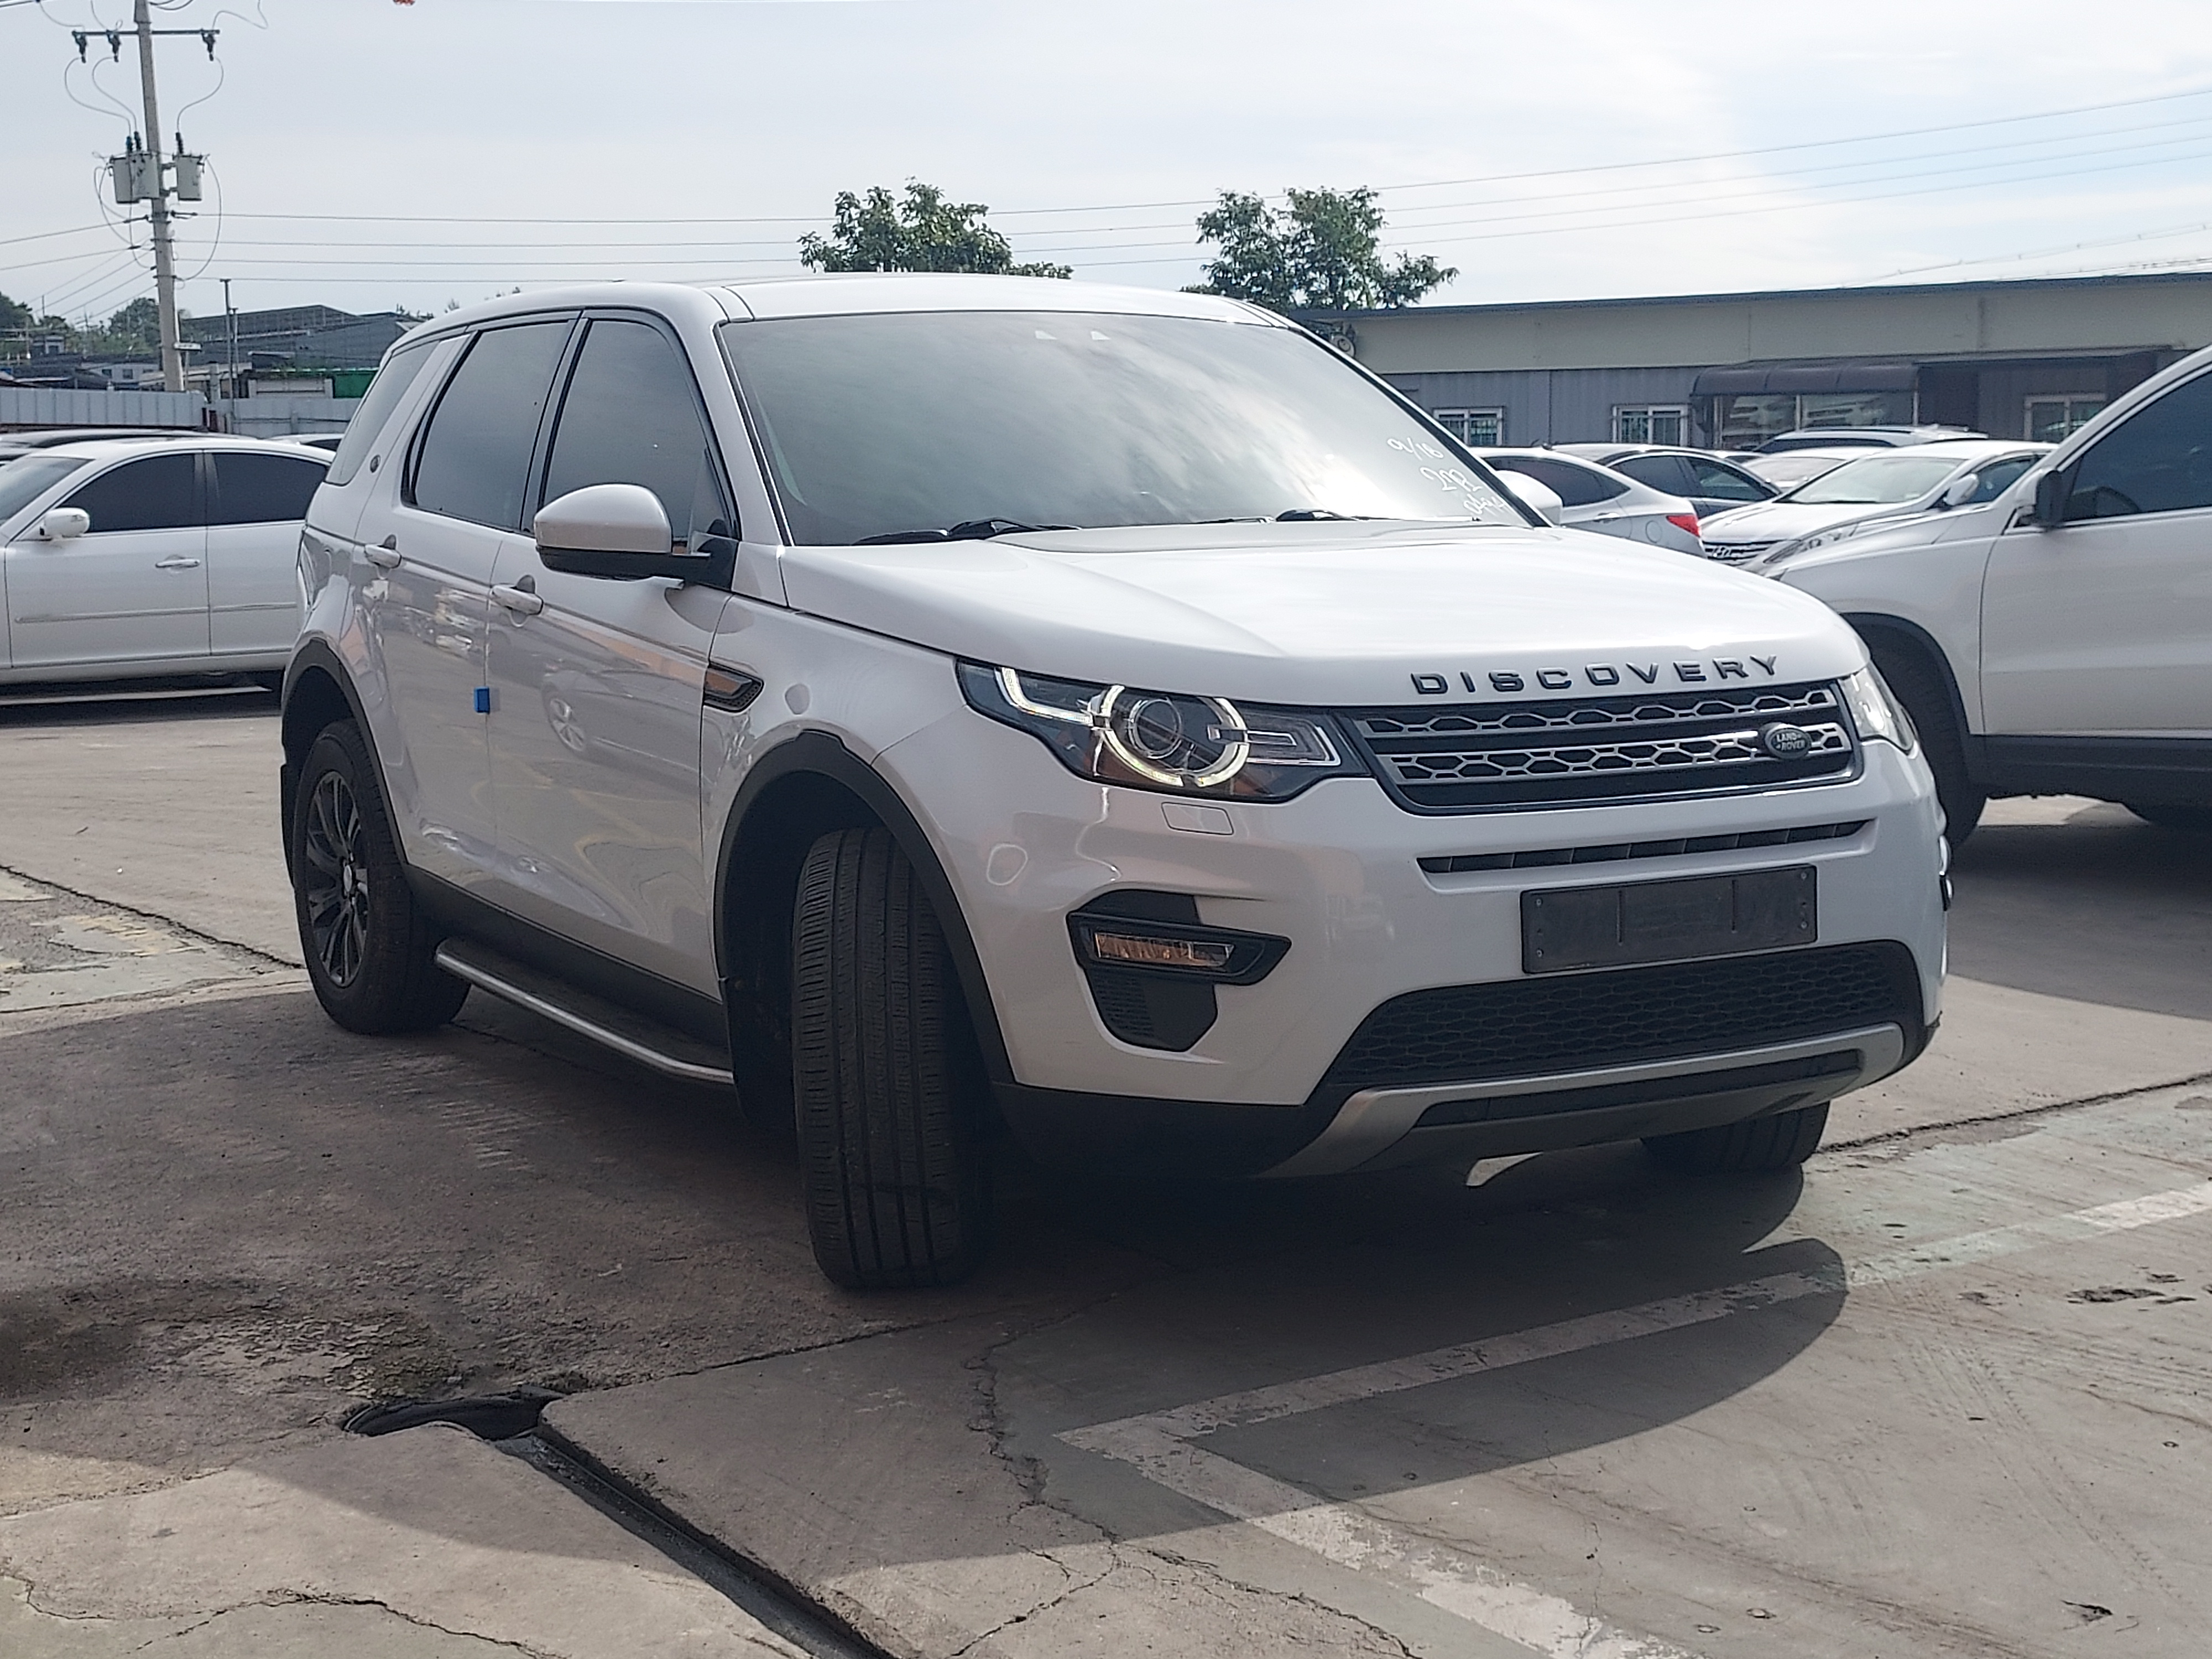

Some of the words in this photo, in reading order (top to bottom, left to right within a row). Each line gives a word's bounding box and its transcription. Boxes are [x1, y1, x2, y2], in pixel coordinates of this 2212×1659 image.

[1411, 654, 1778, 695] DISCOVERY
[1776, 732, 1797, 742] LAND
[1781, 739, 1806, 750] ROVER
